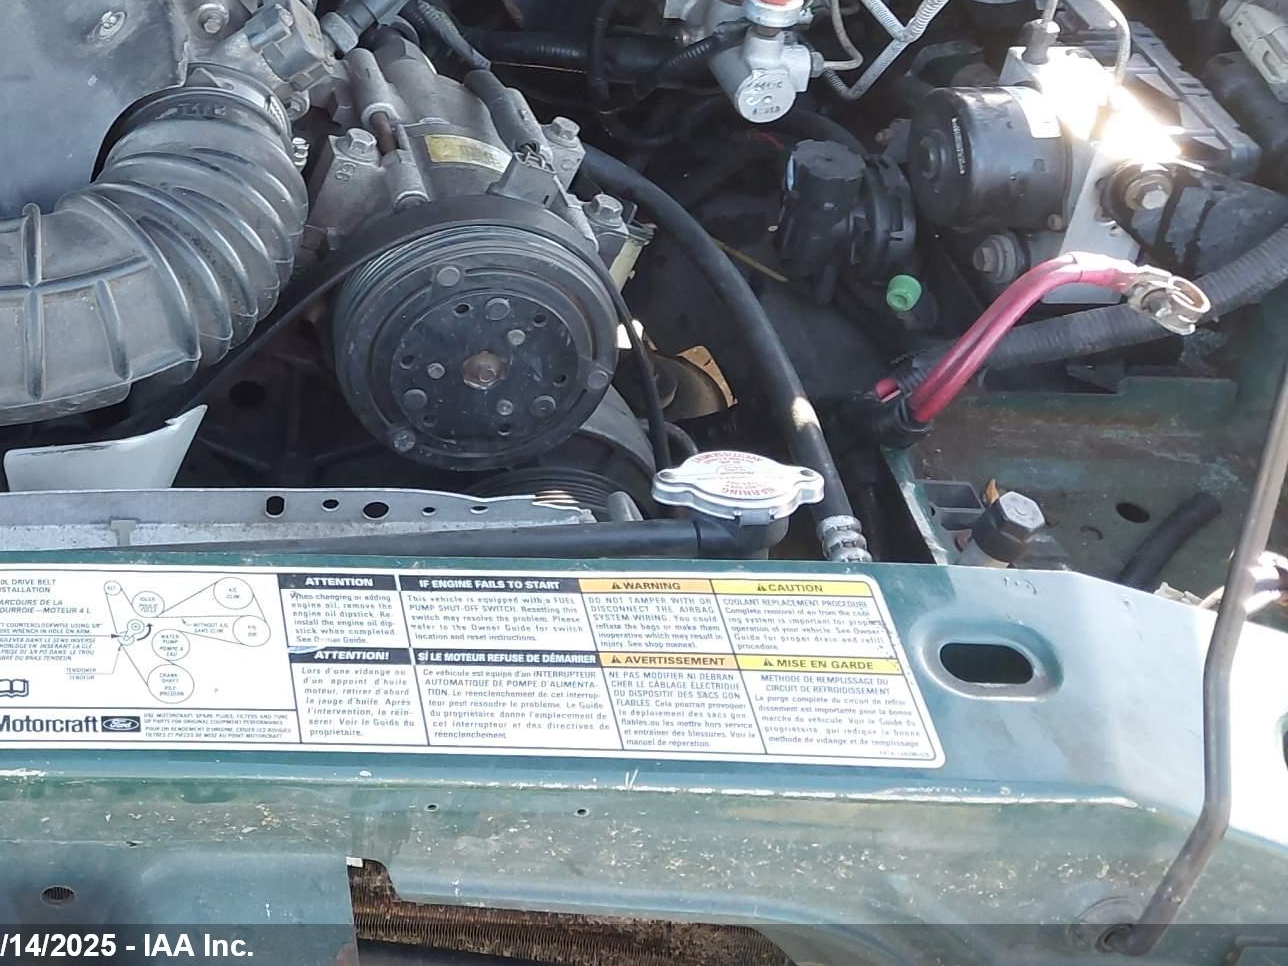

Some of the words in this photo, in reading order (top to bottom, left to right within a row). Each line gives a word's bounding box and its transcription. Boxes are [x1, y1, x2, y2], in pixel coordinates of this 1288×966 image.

[305, 578, 373, 586] ATTENTION
[432, 580, 473, 588] ENGINE
[475, 580, 505, 589] FAILS
[507, 581, 523, 589] TO
[526, 581, 559, 589] START
[769, 584, 823, 592] CAUTION
[314, 651, 389, 660] ATTENTION!
[430, 653, 443, 661] LE
[444, 653, 486, 662] MOTEUR
[487, 654, 524, 662] REFUSE
[525, 654, 540, 662] DE
[542, 652, 596, 662] DÉMARRER
[625, 657, 726, 666] AVERTISSEMENT
[777, 659, 806, 667] MISE
[812, 660, 827, 668] EN
[831, 661, 874, 670] GARDE
[425, 679, 489, 687] AUTOMATIQUE
[817, 676, 873, 684] REMPLISSAGE
[629, 690, 674, 698] DISPOSITIF
